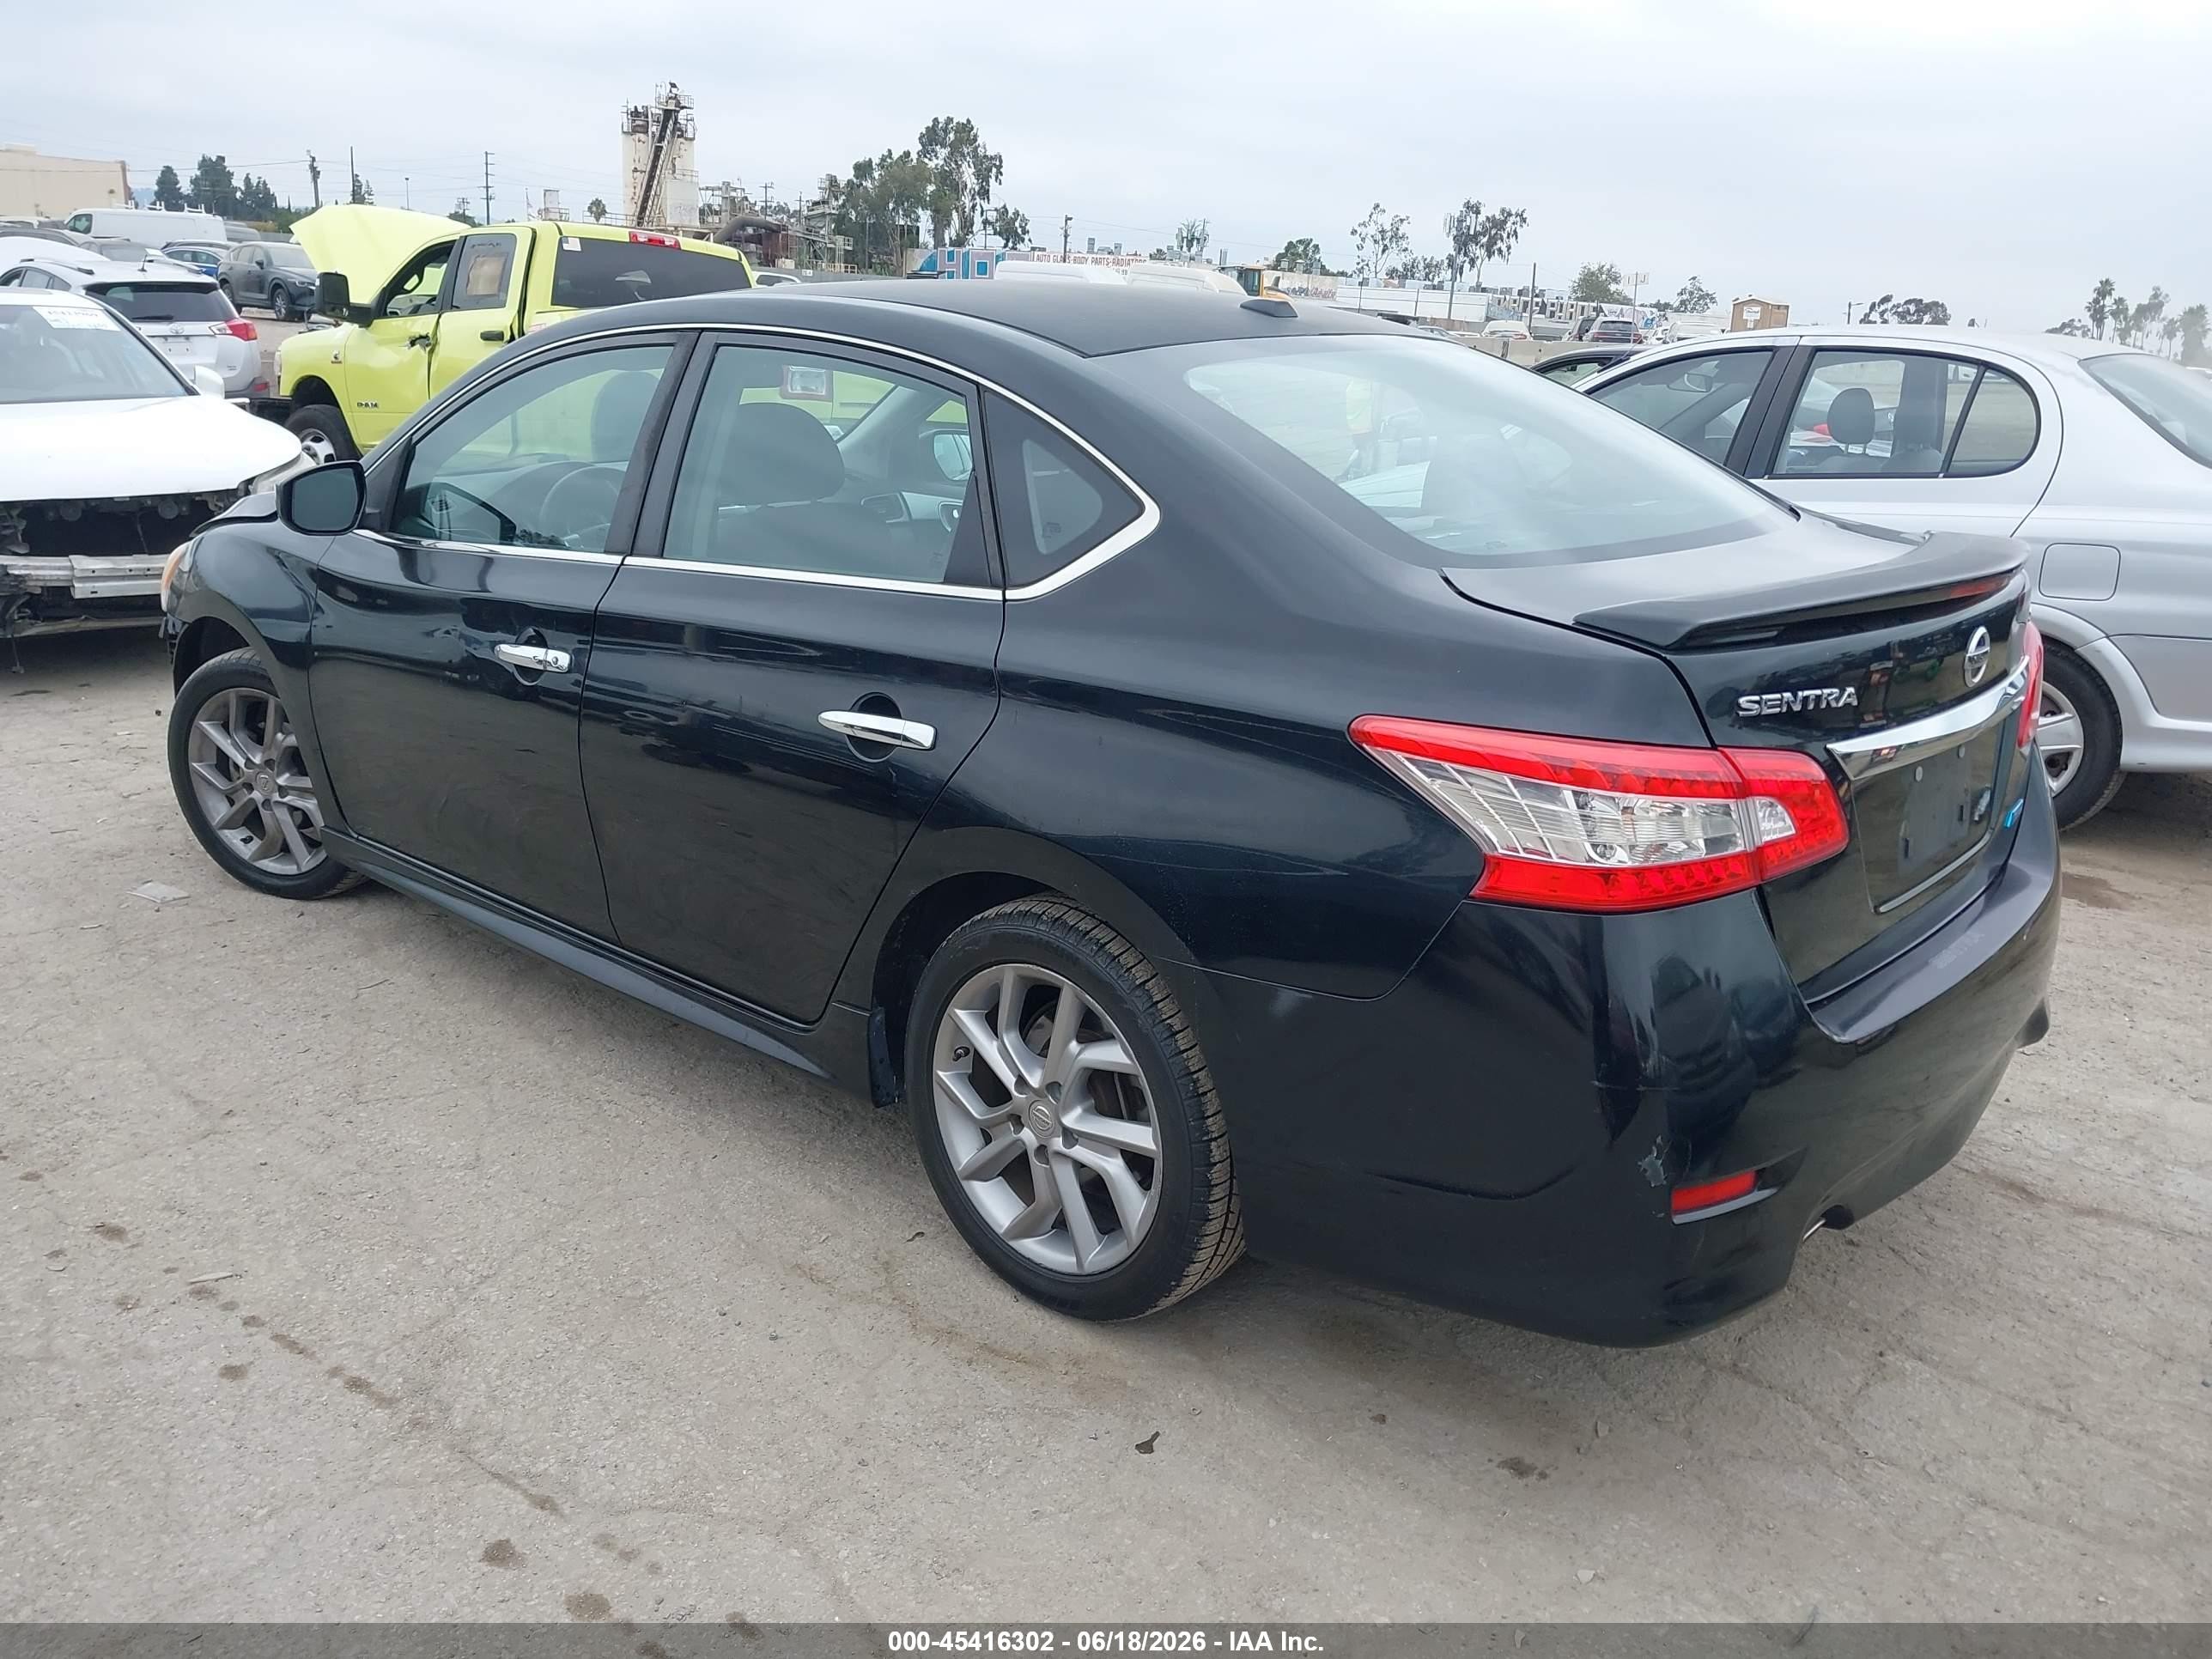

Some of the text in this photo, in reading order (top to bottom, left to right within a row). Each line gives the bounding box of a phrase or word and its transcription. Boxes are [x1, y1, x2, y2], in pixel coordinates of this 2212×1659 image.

[1036, 253, 1051, 263] AUTO
[1052, 254, 1089, 264] GLAS-BODY
[1736, 686, 1859, 718] SENTRA
